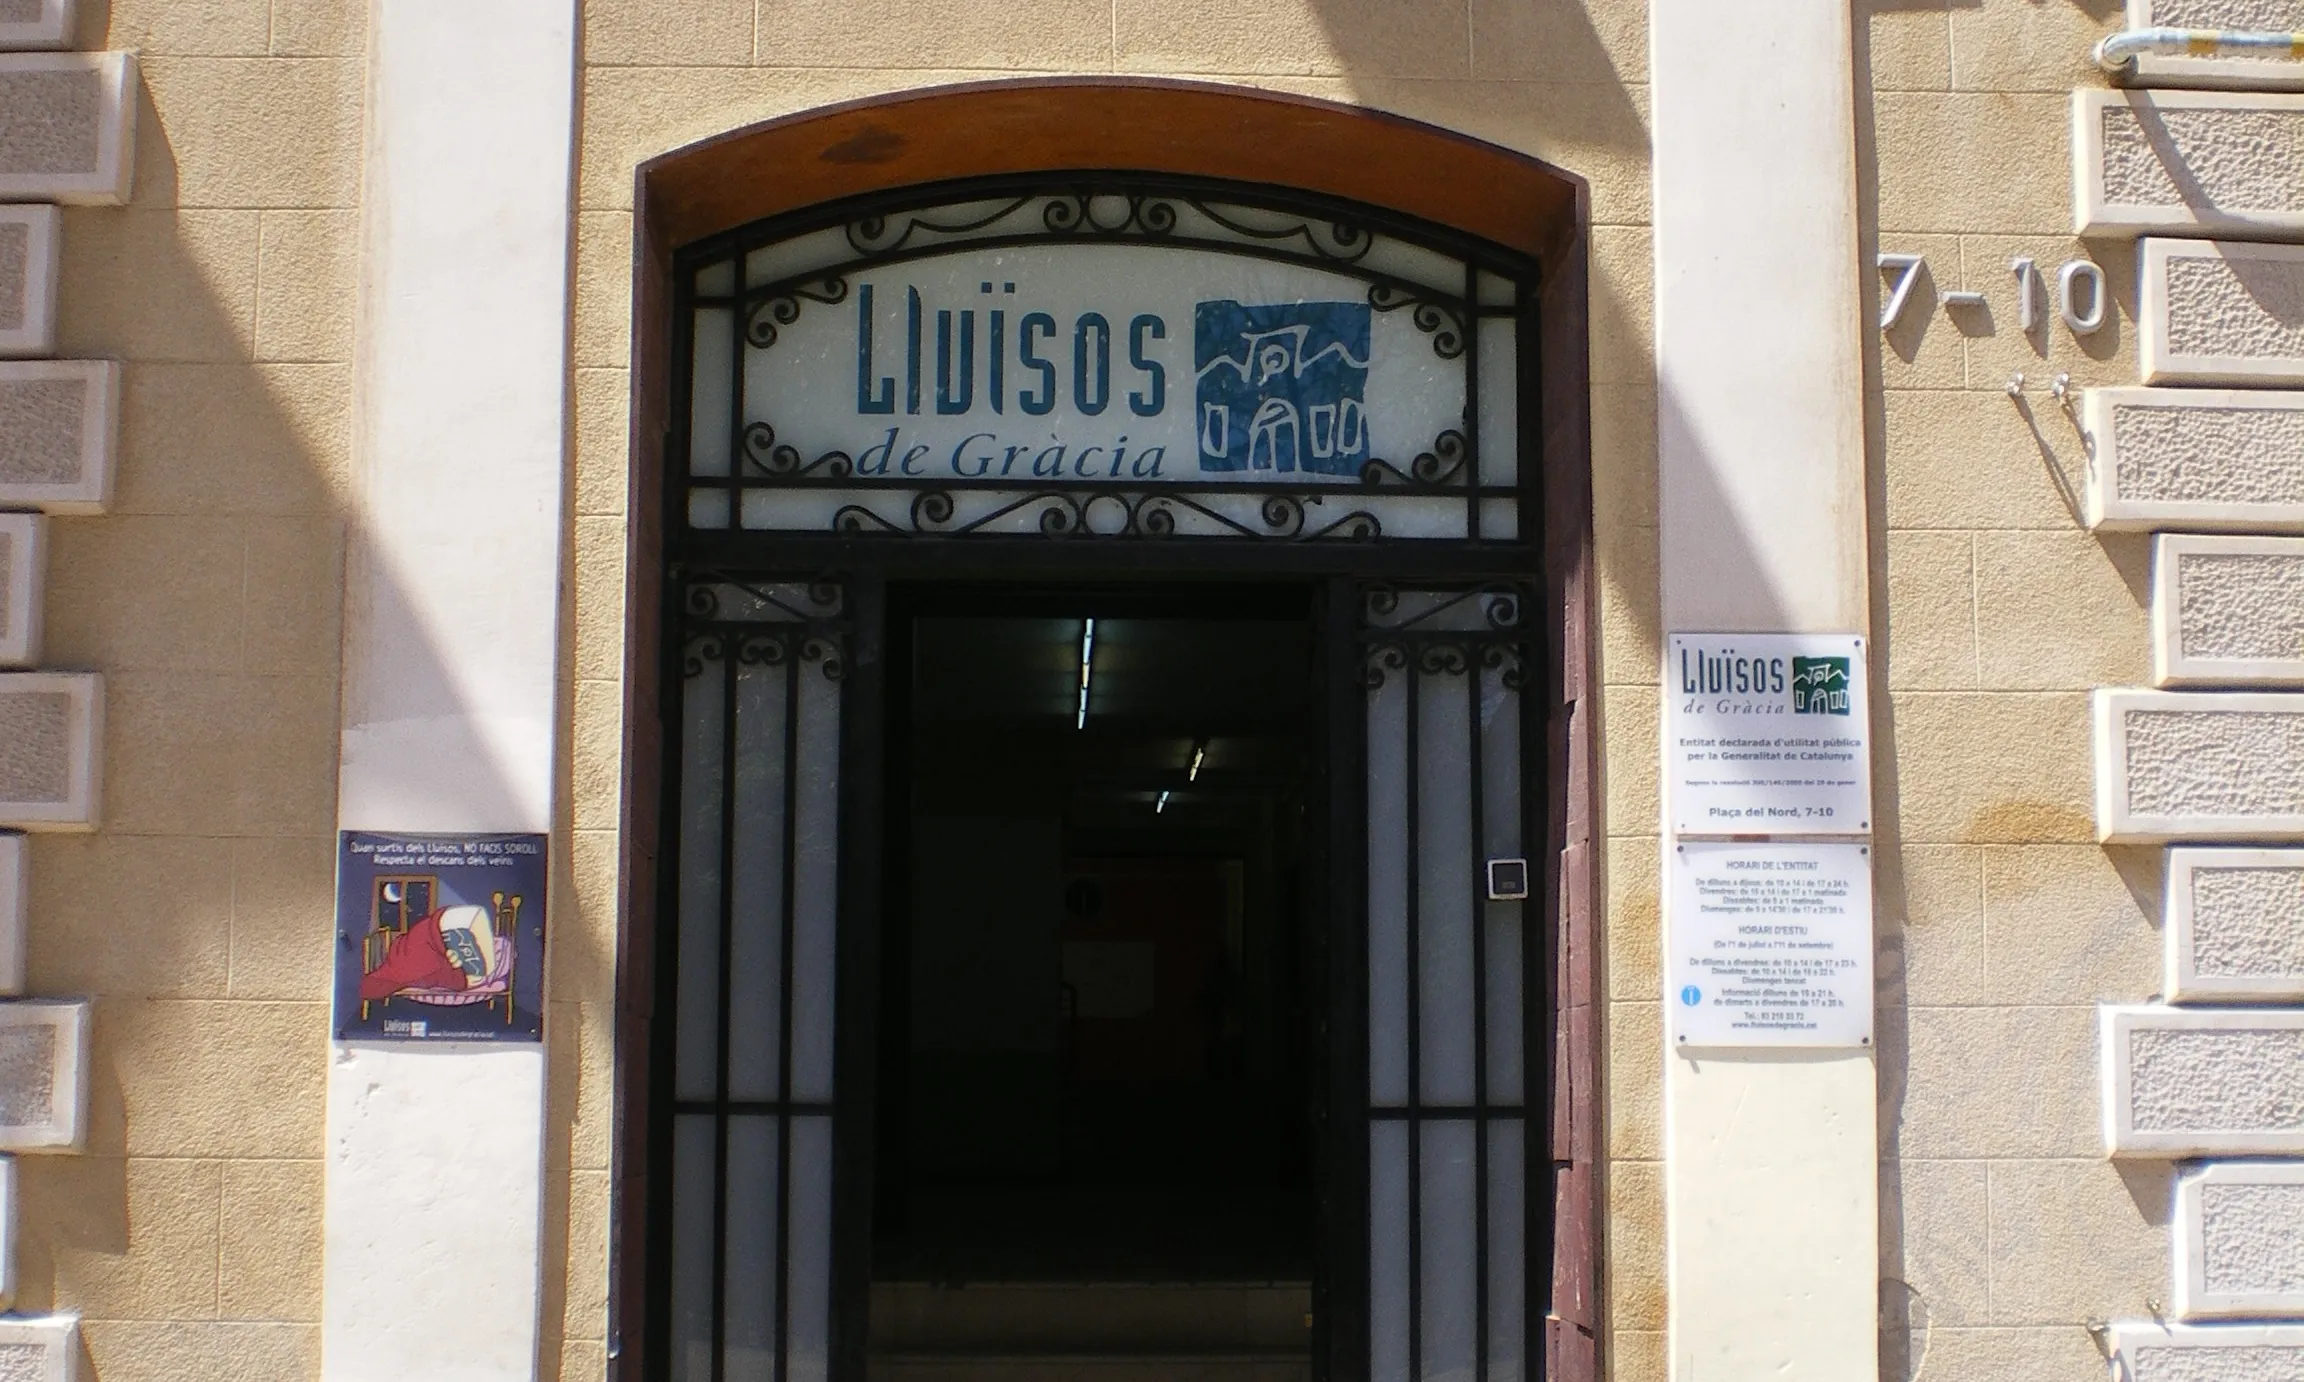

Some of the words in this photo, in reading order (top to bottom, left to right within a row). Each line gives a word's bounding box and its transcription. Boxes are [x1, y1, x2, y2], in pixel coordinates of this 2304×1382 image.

[1877, 253, 2107, 335] 7-10
[857, 281, 1167, 417] Lluïsos
[856, 427, 931, 477] de
[951, 432, 1167, 478] Gràcia
[1682, 648, 1785, 694] Lluïsos
[1683, 699, 1705, 714] de
[1716, 699, 1785, 715] Gràcia
[1679, 738, 1715, 747] Entitat
[1719, 738, 1770, 747] declarada
[1774, 738, 1820, 748] d'utilitat
[1823, 738, 1861, 749] pública
[1687, 753, 1705, 762] per
[1708, 752, 1718, 761] la
[1721, 752, 1780, 761] Generalitat
[1784, 752, 1797, 761] de
[1800, 752, 1853, 763] Catalunya
[1709, 807, 1740, 820] Plaça
[1745, 807, 1764, 817] del
[1768, 807, 1801, 819] Nord,
[1805, 807, 1833, 817] 7-10
[463, 841, 477, 853] NO
[505, 841, 538, 855] SOROLL
[373, 856, 413, 866] Respecta
[1726, 861, 1760, 870] HORARI
[1762, 861, 1774, 870] DE
[1776, 861, 1819, 870] L'ENTITAT
[1739, 926, 1772, 935] HORARI
[1775, 926, 1808, 935] D'ESTIU
